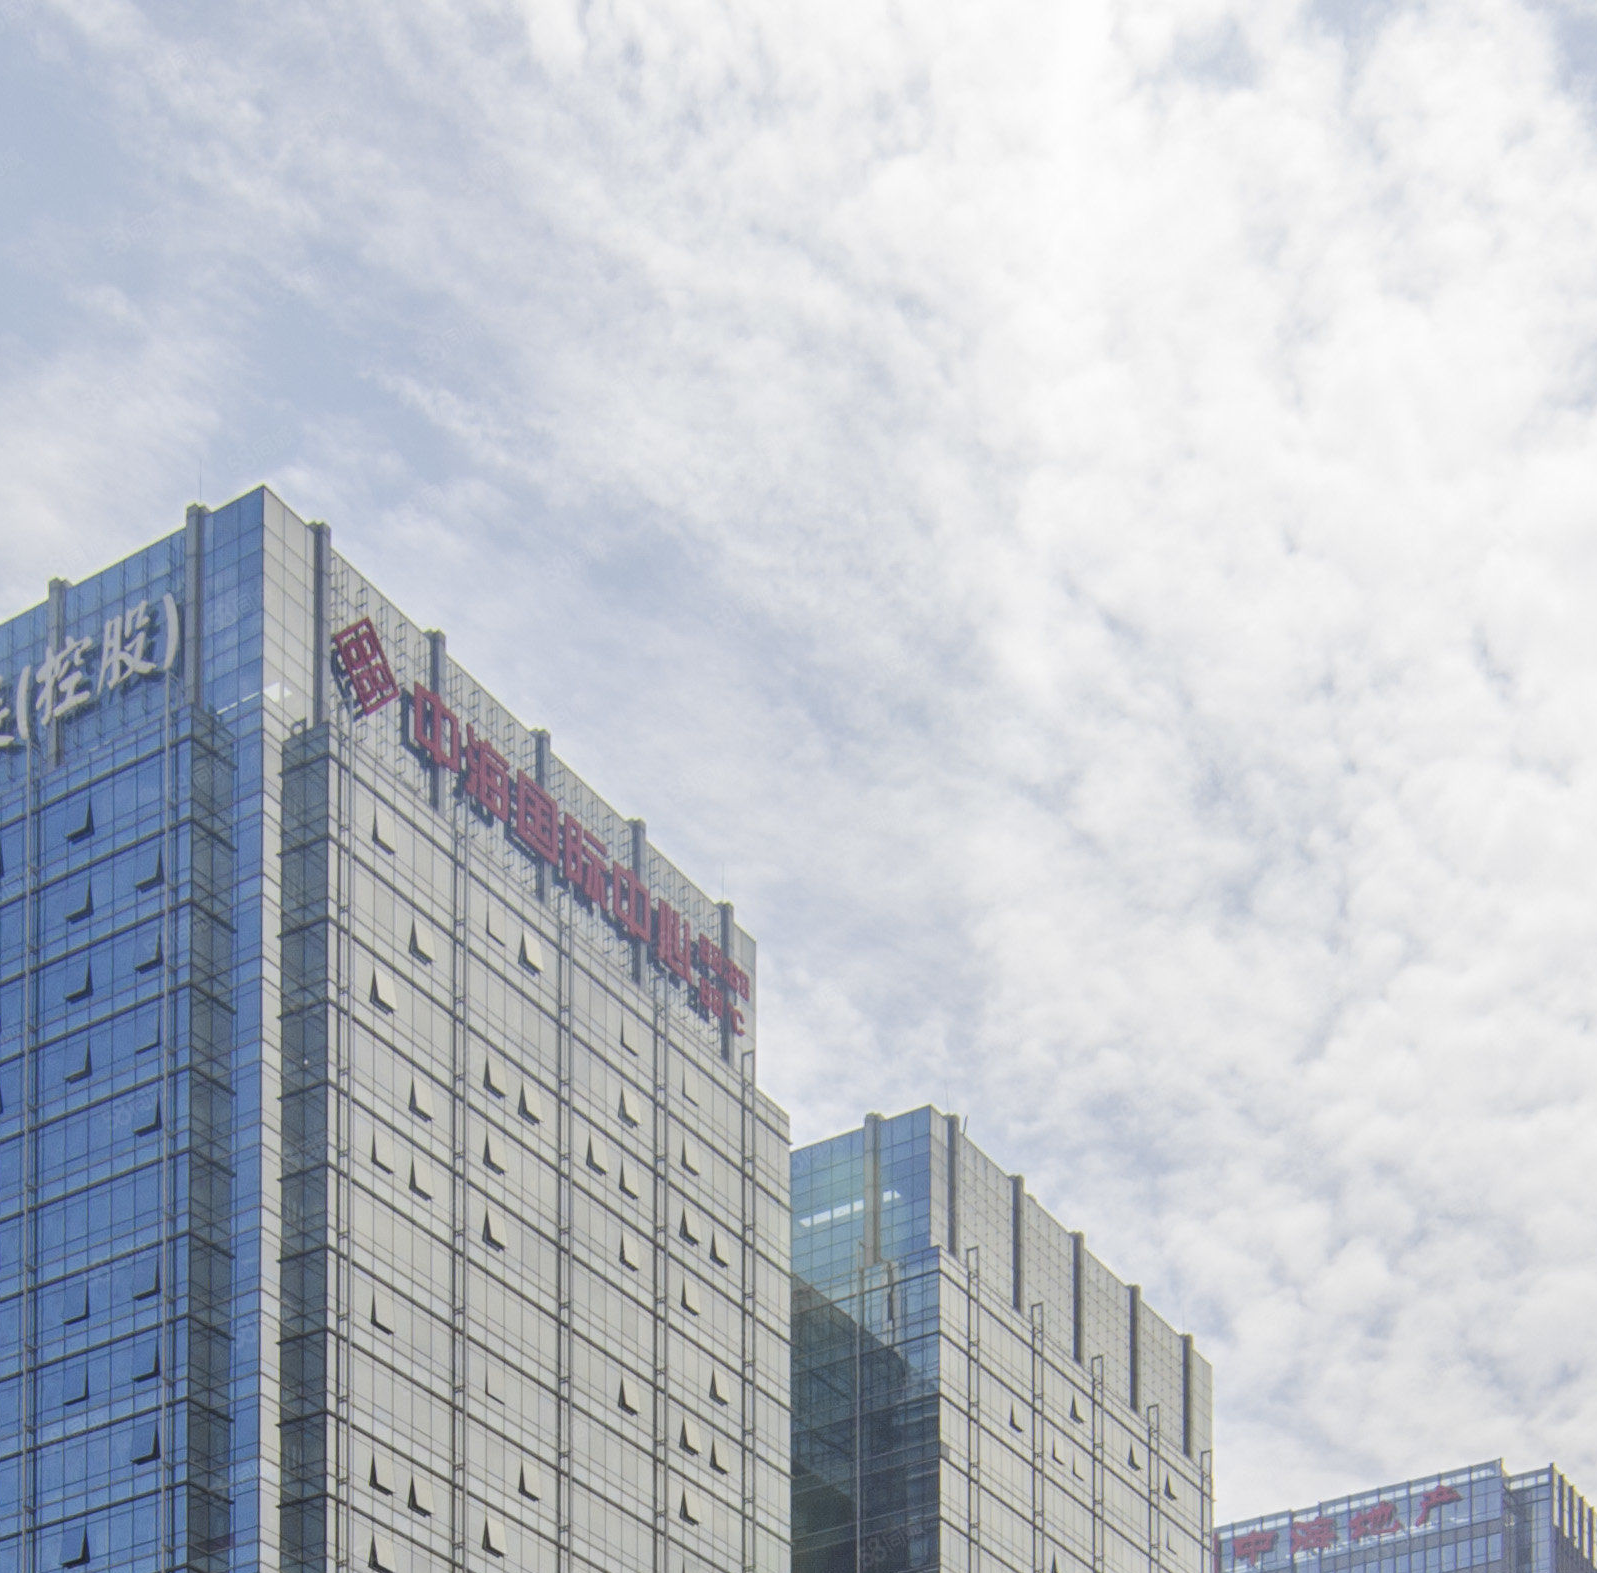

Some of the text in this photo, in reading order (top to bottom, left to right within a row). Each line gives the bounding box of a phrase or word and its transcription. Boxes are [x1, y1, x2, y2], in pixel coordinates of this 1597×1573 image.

[413, 682, 692, 985] 中海国际中心
